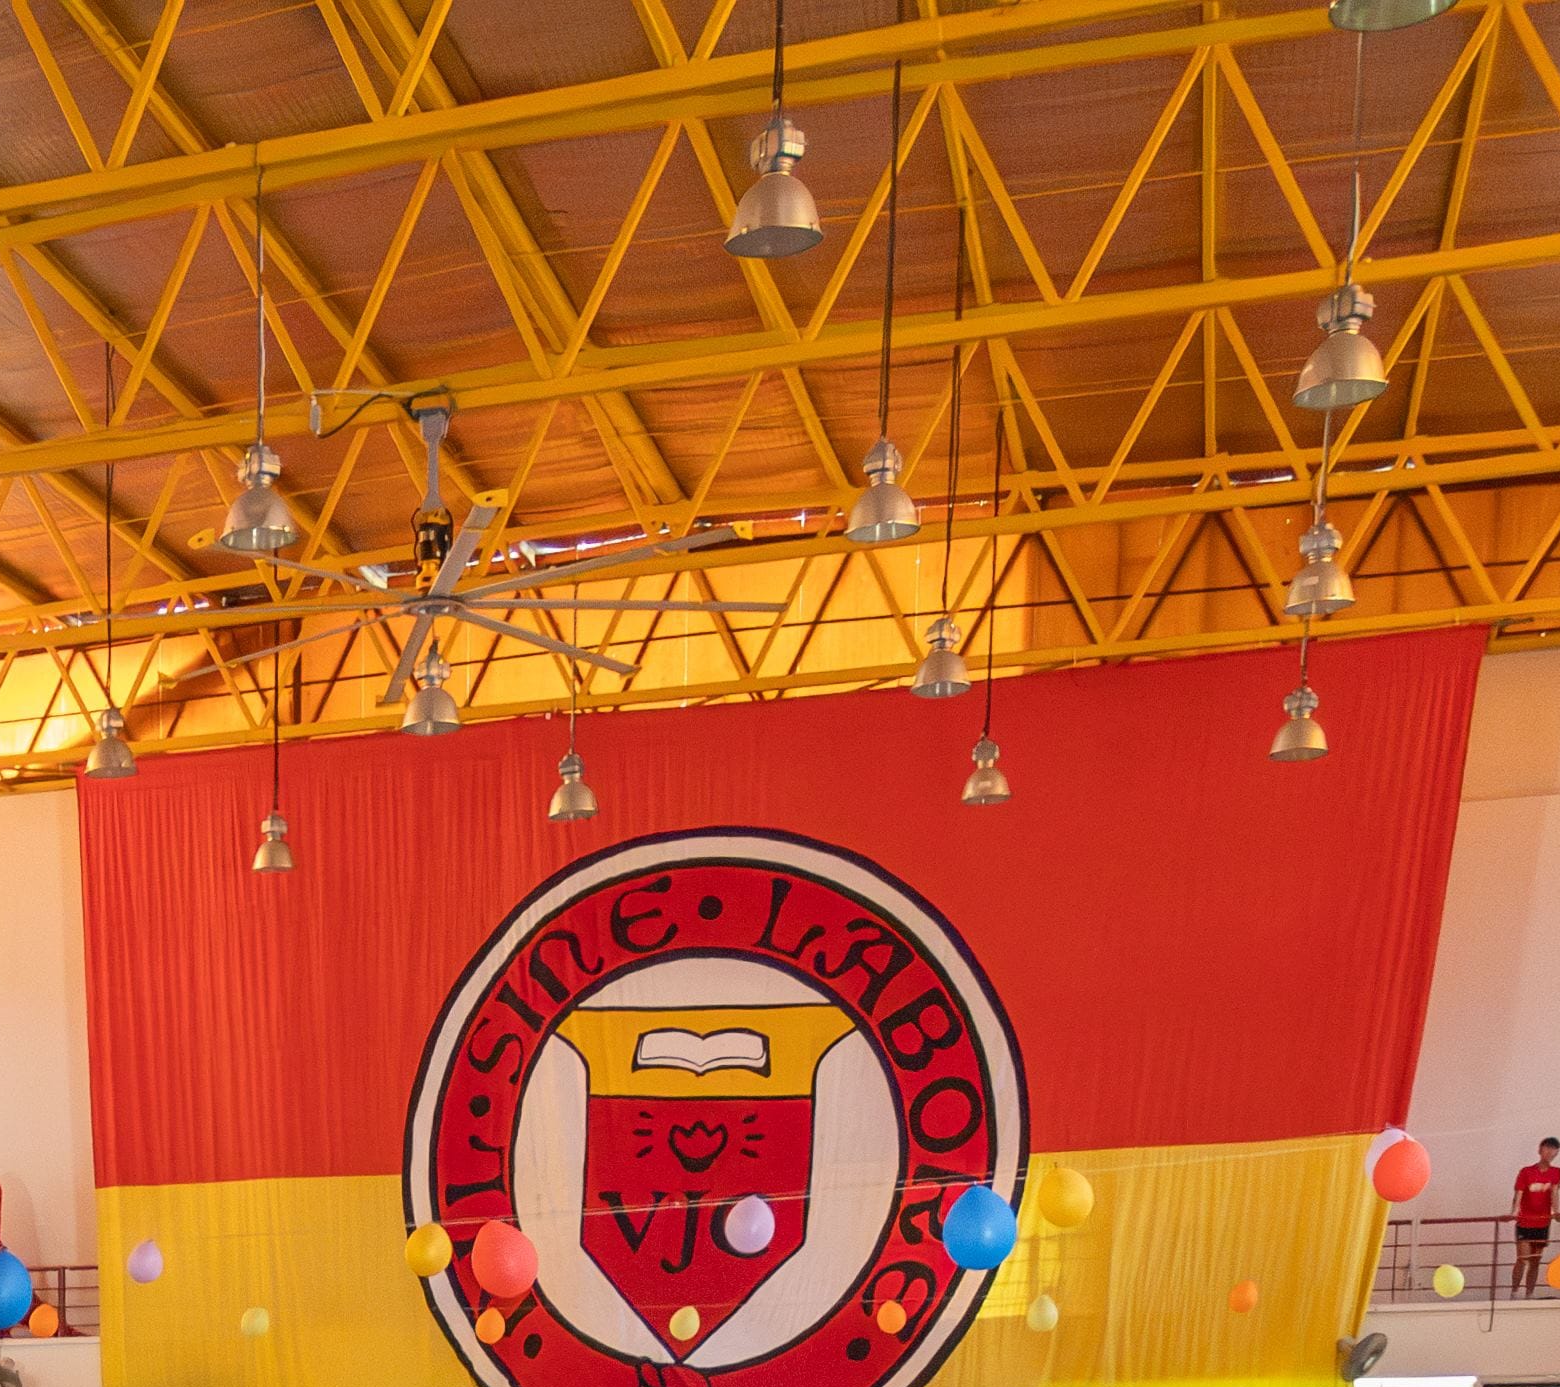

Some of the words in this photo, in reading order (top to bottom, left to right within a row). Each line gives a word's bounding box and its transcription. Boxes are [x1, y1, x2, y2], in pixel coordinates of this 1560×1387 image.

[467, 876, 678, 1085] SINE
[753, 877, 983, 1343] LABORE
[598, 1190, 771, 1274] VJC
